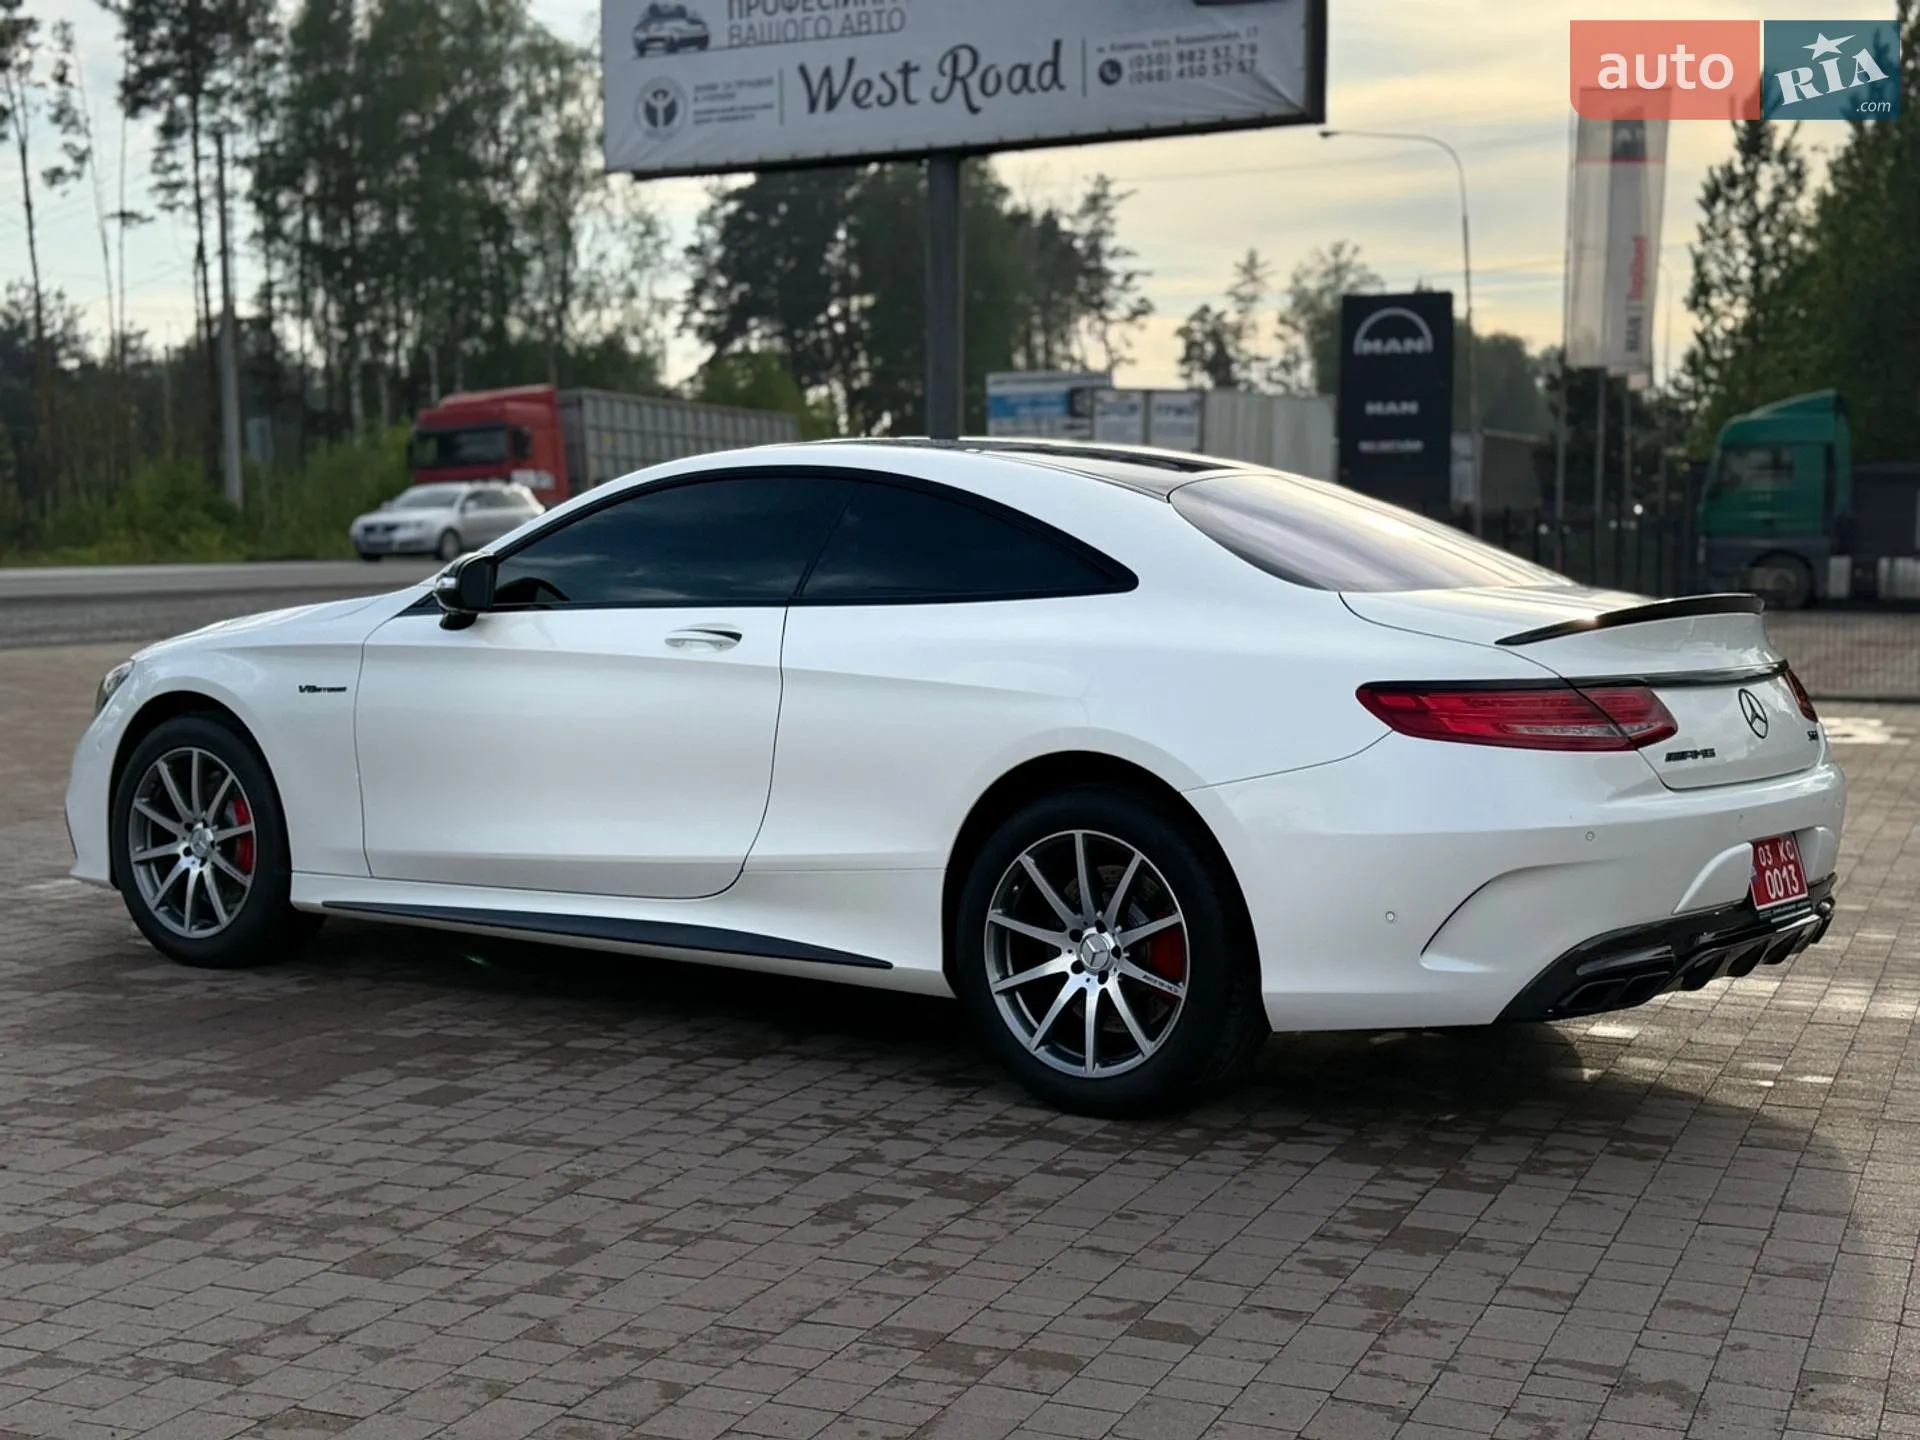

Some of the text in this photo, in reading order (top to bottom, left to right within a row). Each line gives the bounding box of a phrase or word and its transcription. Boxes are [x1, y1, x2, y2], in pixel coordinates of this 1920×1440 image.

[728, 6, 907, 47] ВАШОГО АВТО
[797, 39, 1067, 115] West Road
[1361, 336, 1425, 355] MAN
[1758, 844, 1773, 867] 03
[1765, 863, 1800, 900] 0013
